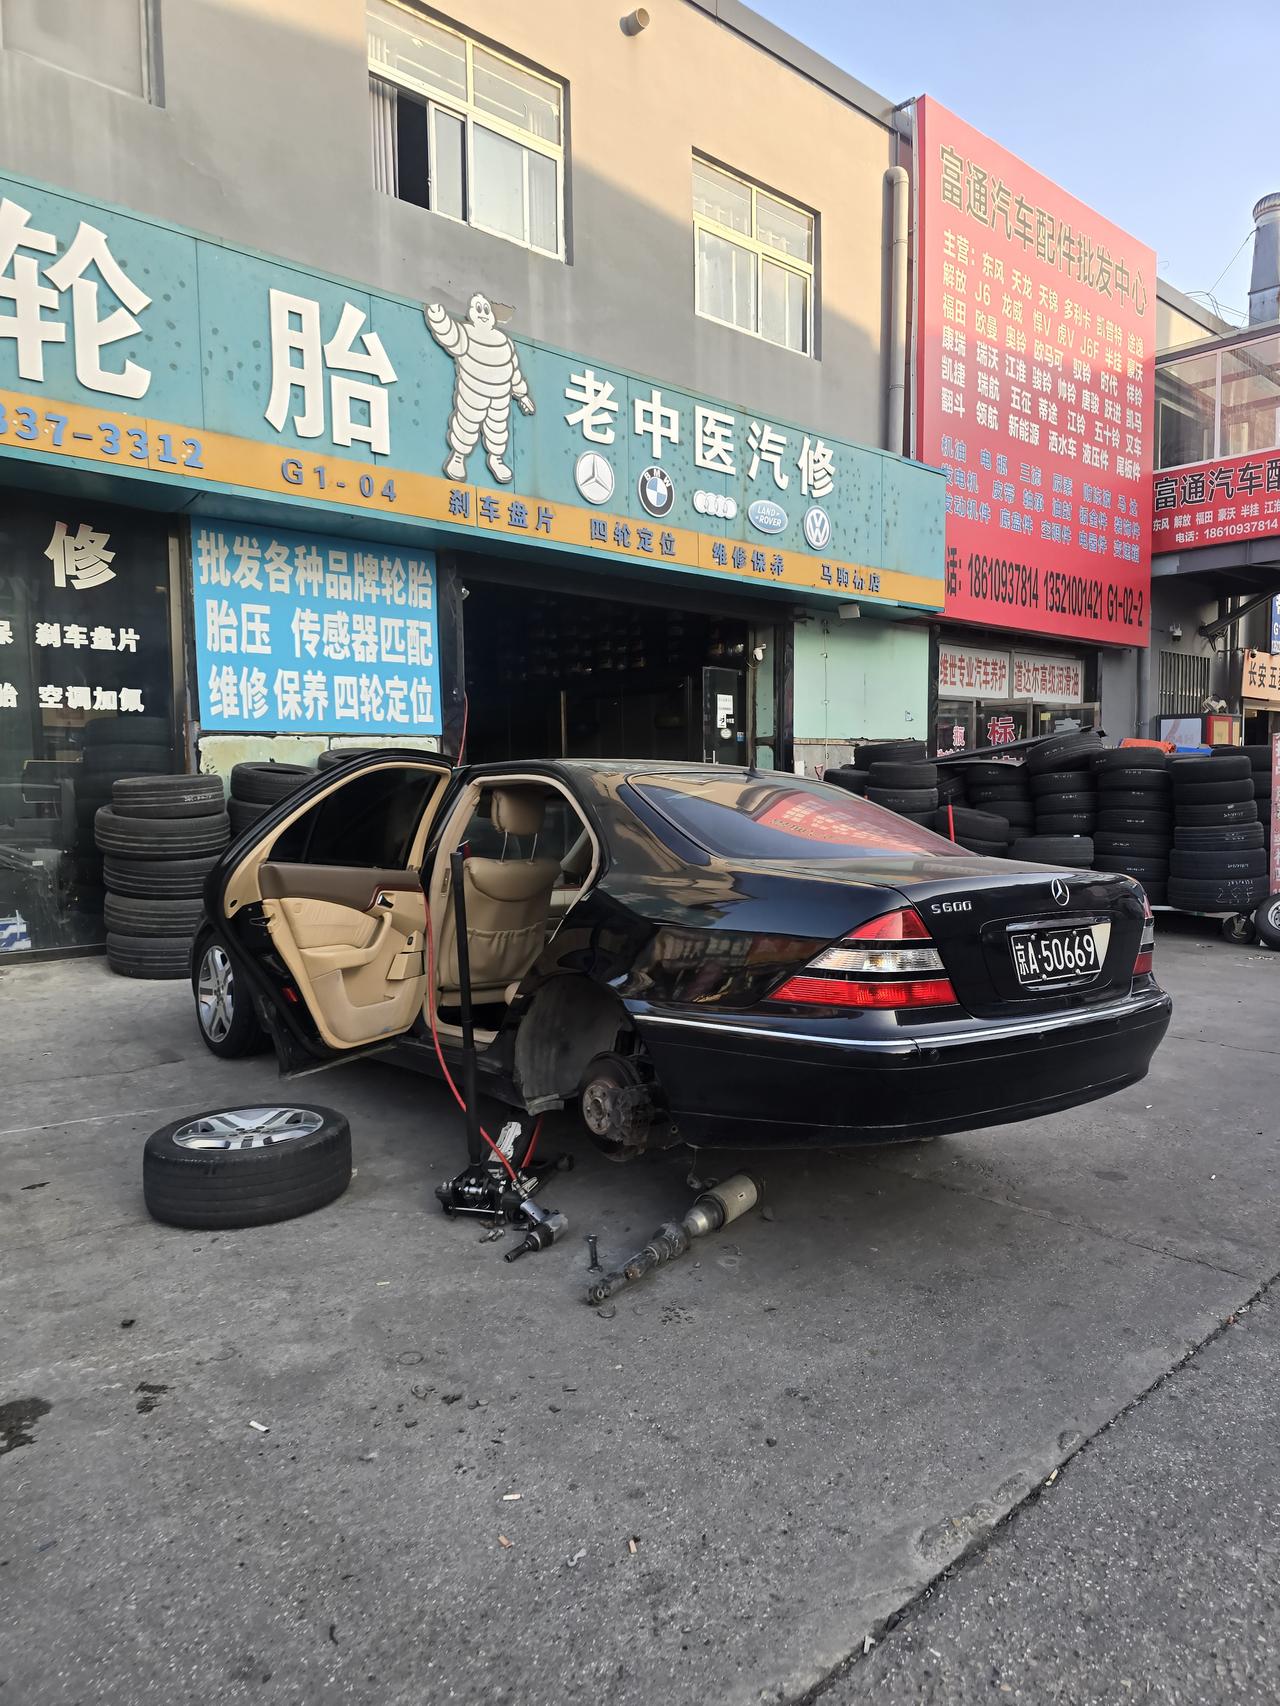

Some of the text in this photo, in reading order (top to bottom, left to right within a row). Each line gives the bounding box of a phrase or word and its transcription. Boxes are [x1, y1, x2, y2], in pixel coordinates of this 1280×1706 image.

[940, 141, 1147, 320] 富通汽车配件批发中心
[942, 260, 966, 296] 解放
[975, 278, 990, 308] J6
[1001, 291, 1023, 324] 龙威
[1080, 333, 1099, 362] J6F
[1105, 345, 1121, 373] 半挂
[1127, 357, 1143, 384] 豪沃
[982, 250, 1004, 285] 东风
[1011, 267, 1032, 300] 天龙
[1038, 282, 1058, 314] 天锦
[1064, 296, 1091, 332] 多利卡
[1096, 313, 1122, 348] 凯普特
[942, 292, 966, 327] 福田
[975, 308, 997, 342] 欧曼
[1005, 323, 1026, 355] 奥铃
[1033, 338, 1063, 373] 欧马可
[1100, 370, 1118, 397] 时代
[941, 354, 965, 388] 凯捷
[977, 370, 999, 402] 瑞航
[1010, 385, 1031, 415] 五征
[1067, 408, 1085, 436] 江铃
[1094, 420, 1120, 450] 五十铃
[1125, 433, 1141, 458] 叉车
[976, 340, 998, 372] 瑞沃
[1005, 353, 1026, 384] 江淮
[1082, 388, 1099, 415] 唐骏
[1104, 397, 1121, 424] 跃进
[1126, 407, 1142, 433] 凯马
[564, 370, 837, 498] 老中医汽修
[941, 386, 965, 419] 翻斗
[976, 400, 998, 431] 领航
[1008, 413, 1039, 446] 新能源
[1048, 429, 1076, 460] 洒水车
[1082, 442, 1108, 471] 液压件
[941, 433, 966, 463] 机油
[644, 469, 671, 488] BMW
[757, 504, 776, 517] LAND
[449, 489, 556, 533] 刹车盘片
[590, 518, 677, 556] 四轮定位
[712, 542, 785, 576] 维修保养
[759, 514, 782, 527] ROVER
[1153, 517, 1169, 531] 东风
[1196, 510, 1213, 525] 福田
[198, 530, 434, 609] 批发各种品牌轮胎
[1044, 569, 1102, 620] 13521001421
[1107, 584, 1142, 627] G1-02-2
[35, 622, 140, 652] 刹车盘片
[206, 600, 433, 666] 胎压 传感器匹配
[1015, 660, 1079, 696] 道达尔高级润滑油
[1248, 661, 1280, 690] 长安五
